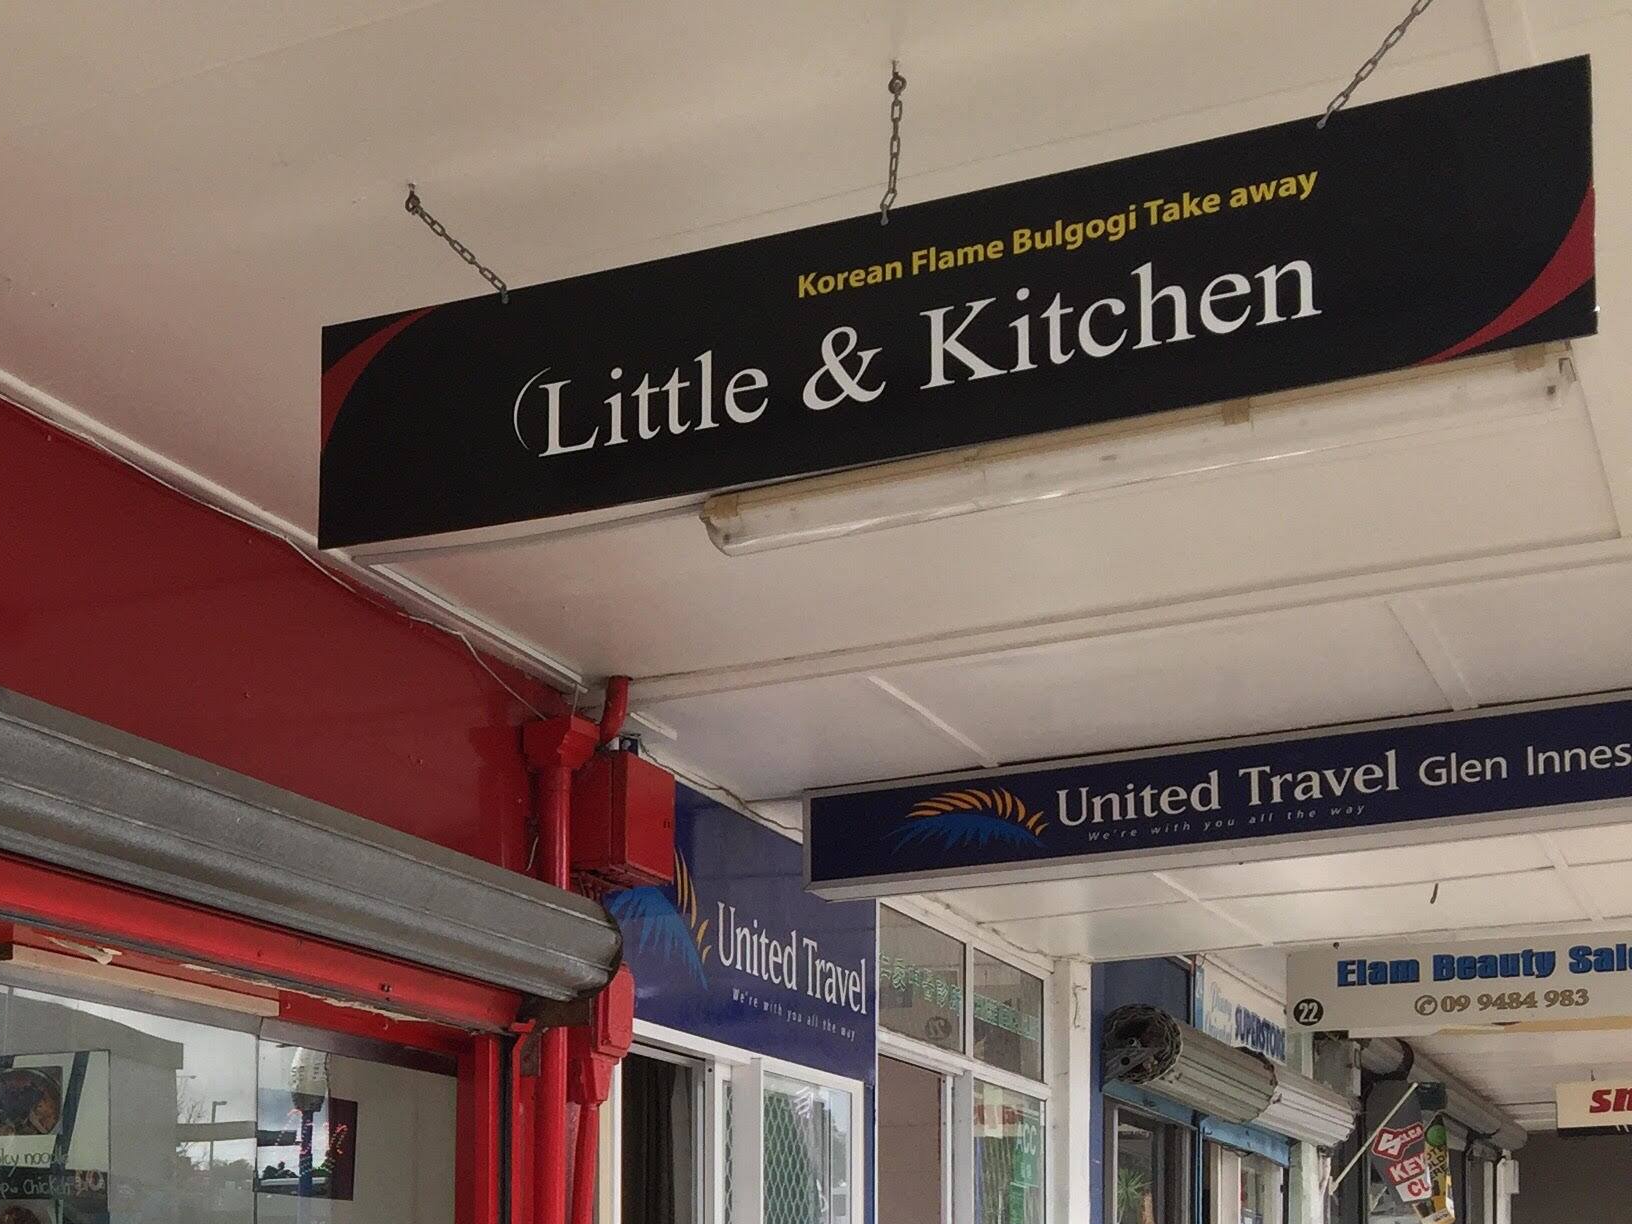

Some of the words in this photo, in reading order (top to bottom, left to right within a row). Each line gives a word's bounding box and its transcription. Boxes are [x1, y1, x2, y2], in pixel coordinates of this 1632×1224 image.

[797, 261, 903, 298] Korean
[913, 242, 1005, 274] Flame
[1014, 214, 1137, 255] Bulgogi
[1145, 194, 1221, 225] Take
[1231, 173, 1318, 208] away
[538, 352, 768, 456] Little
[805, 328, 886, 410] &
[920, 260, 1322, 390] Kitchen
[1057, 773, 1221, 827] United
[1238, 751, 1400, 807] Travel
[1419, 753, 1508, 788] Glen
[1526, 739, 1632, 776] Innes
[1088, 827, 1138, 842] We're
[1151, 820, 1191, 837] with
[1203, 817, 1236, 832] you
[1249, 812, 1274, 825] all
[1286, 806, 1319, 820] the
[1330, 803, 1366, 819] way
[717, 901, 798, 991] United
[802, 937, 867, 1015] Travel
[1432, 949, 1556, 982] Beauty
[763, 1001, 782, 1017] with
[787, 1008, 802, 1023] you
[807, 1011, 818, 1028] all
[1298, 1001, 1319, 1023] 22
[1441, 994, 1471, 1013] 09
[1478, 991, 1539, 1012] 9484
[1544, 988, 1590, 1008] 983
